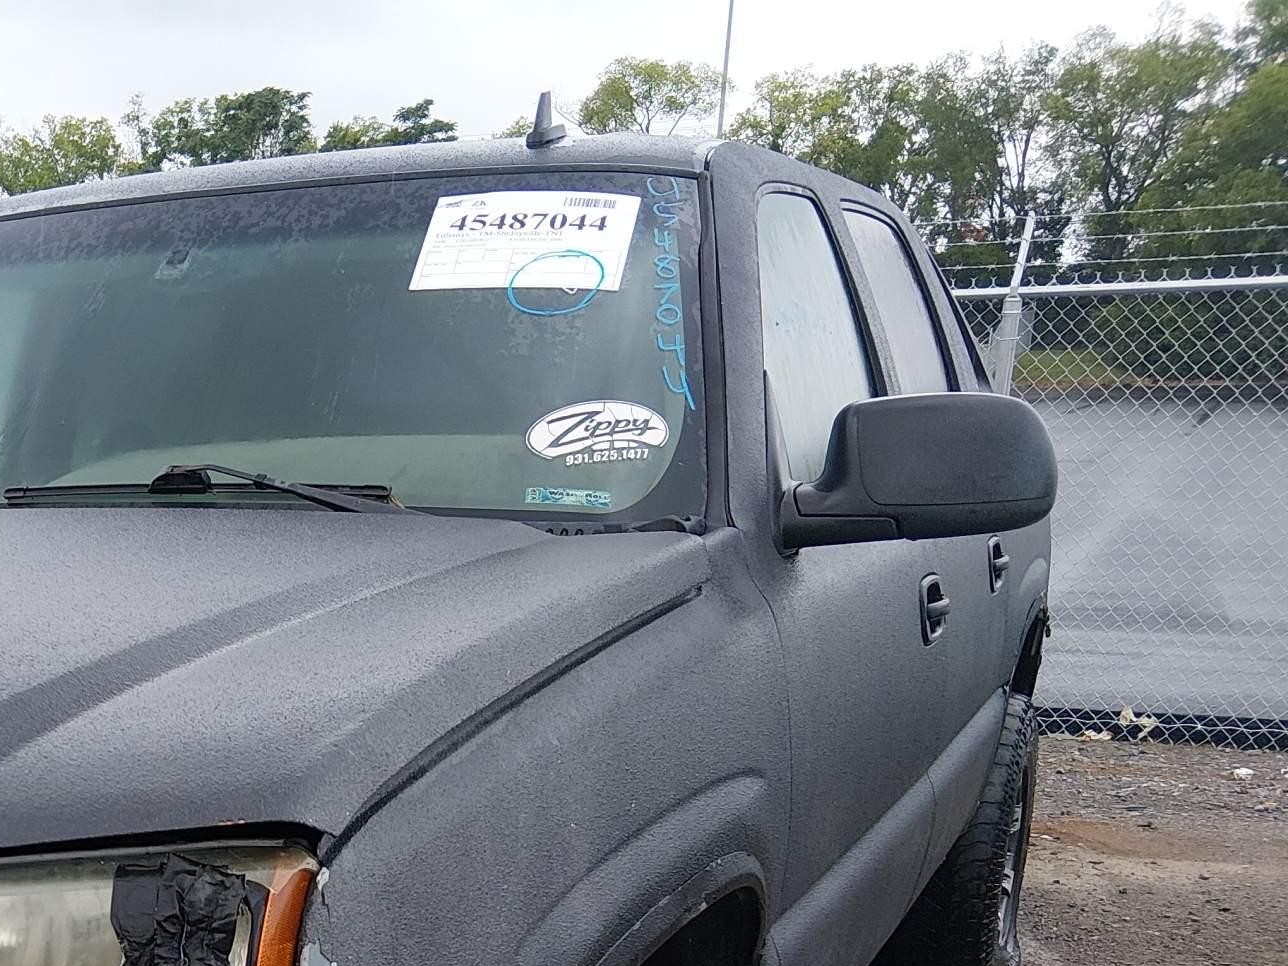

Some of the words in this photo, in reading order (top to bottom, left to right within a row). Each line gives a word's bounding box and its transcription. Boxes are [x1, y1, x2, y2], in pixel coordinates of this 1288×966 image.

[449, 212, 608, 232] 45487044
[542, 410, 656, 449] Zippy
[565, 448, 649, 467] 931.625.1477
